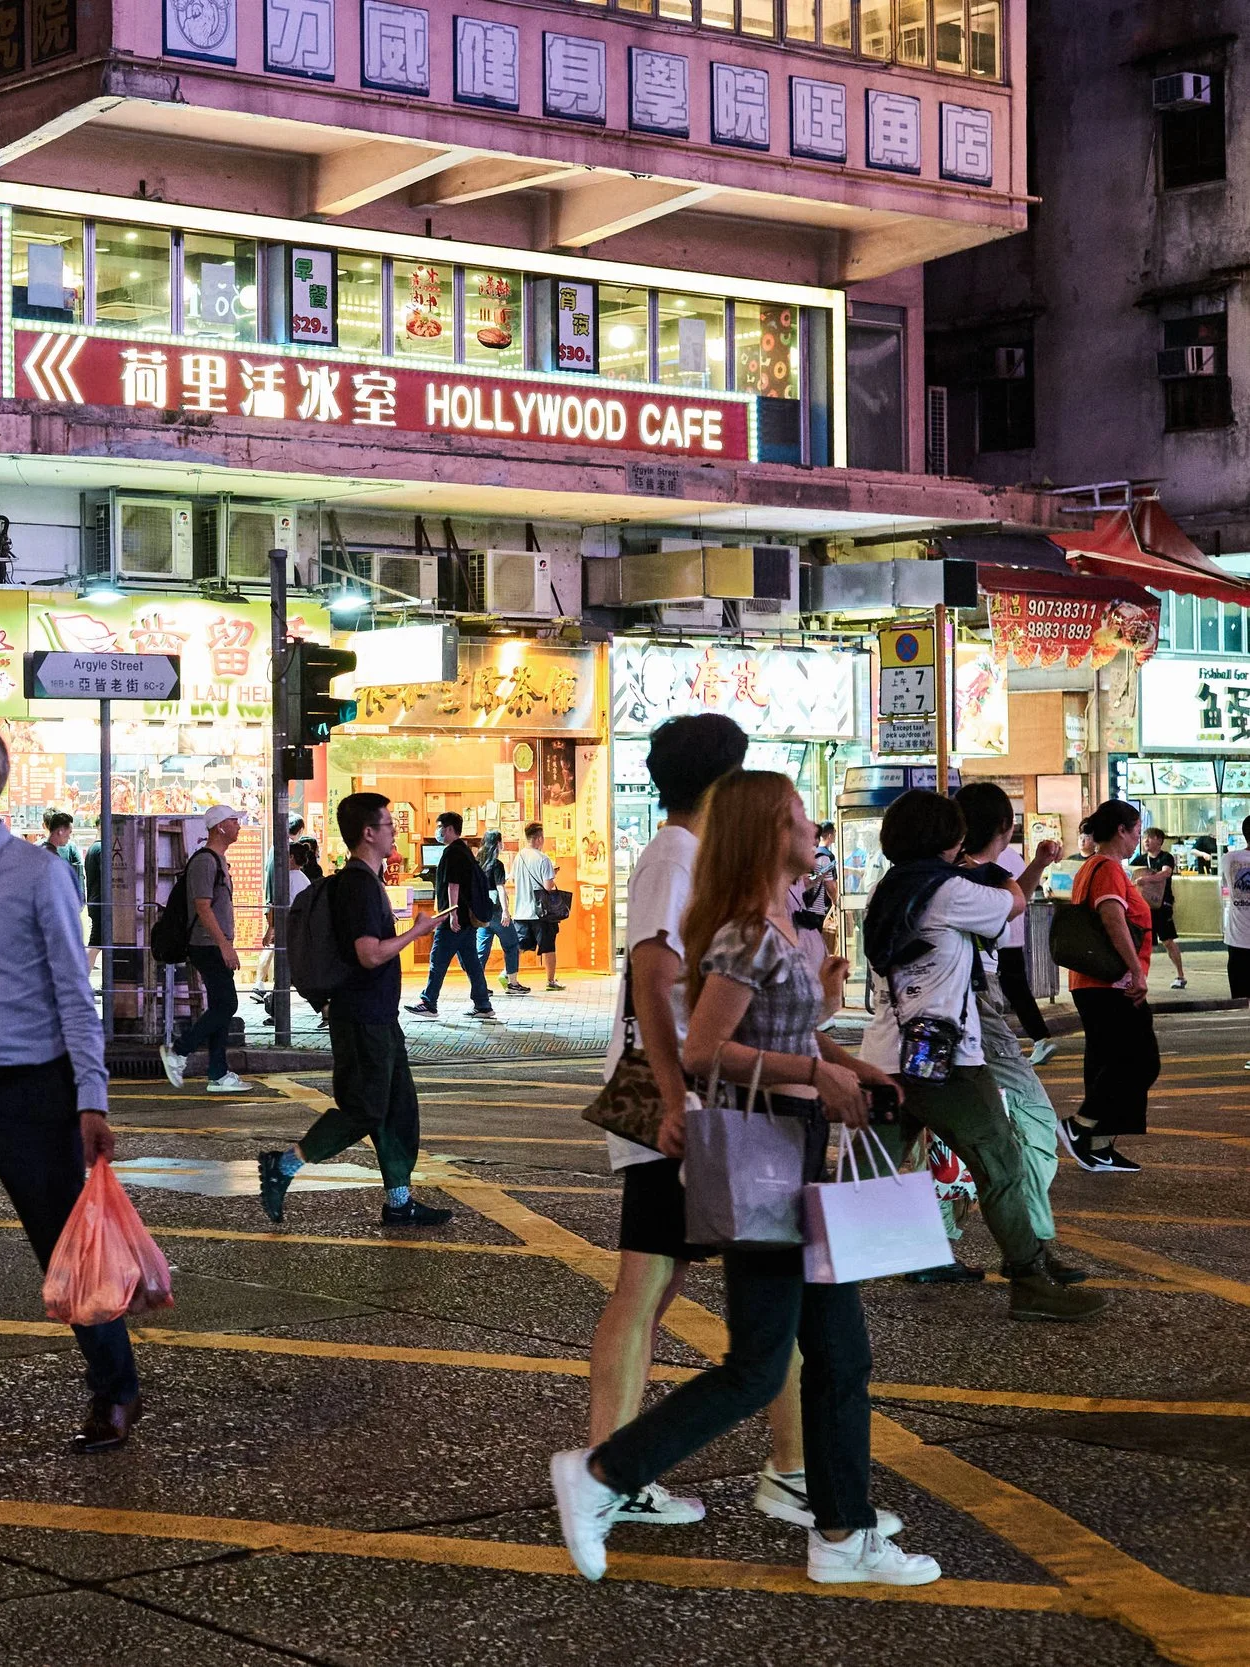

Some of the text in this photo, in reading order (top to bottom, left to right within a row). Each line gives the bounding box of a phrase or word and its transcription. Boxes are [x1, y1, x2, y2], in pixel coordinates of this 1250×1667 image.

[270, 0, 992, 181] 力威健身學院旺角店
[294, 257, 328, 310] 早餐
[560, 286, 590, 337] 宵夜
[293, 314, 321, 334] $29
[559, 343, 585, 362] $30
[120, 349, 397, 427] 荷里活冰室
[427, 382, 723, 450] HOLLYWOOD CAFE
[1028, 599, 1097, 620] 90738311
[1028, 621, 1092, 640] 98831893
[74, 658, 144, 672] Argyle Street
[1199, 667, 1232, 679] Fishball
[78, 677, 139, 693] 亞皆老街
[891, 678, 907, 687] 上午
[915, 670, 925, 686] 7
[194, 685, 229, 702] LAU
[915, 694, 925, 710] 7
[891, 702, 907, 712] 下午
[892, 724, 913, 732] Except
[899, 731, 921, 739] up/drop
[922, 730, 931, 738] off
